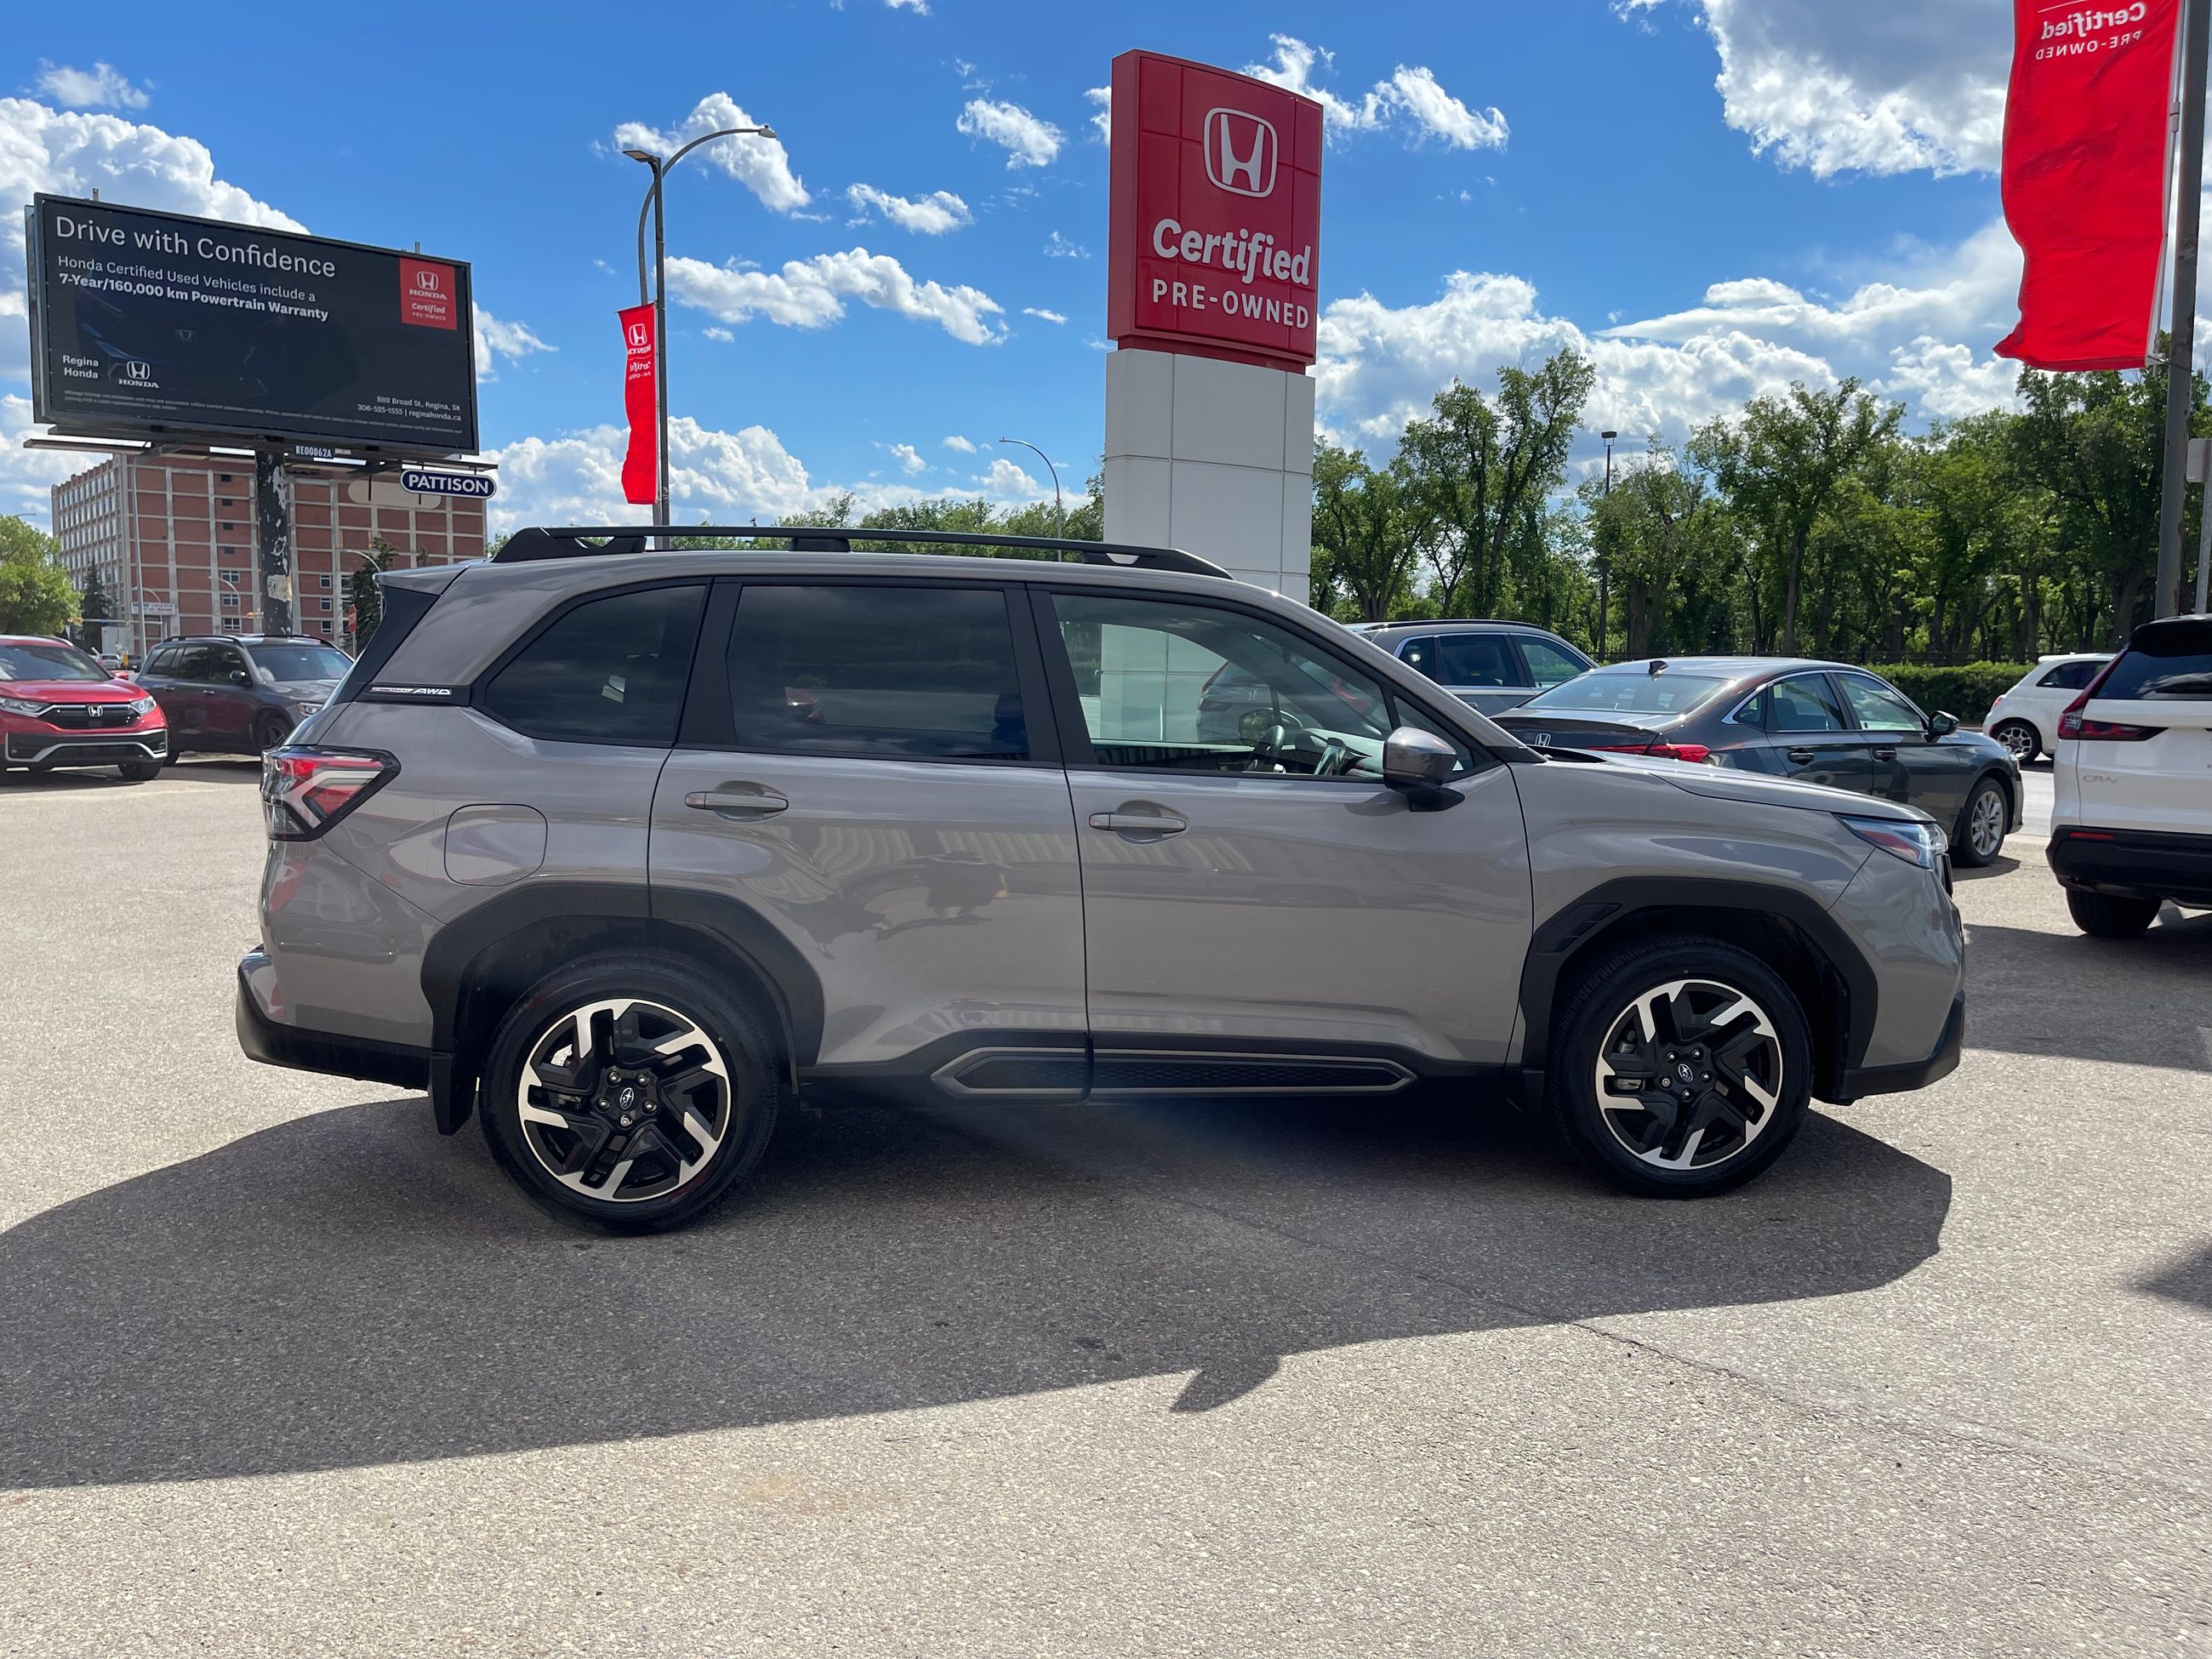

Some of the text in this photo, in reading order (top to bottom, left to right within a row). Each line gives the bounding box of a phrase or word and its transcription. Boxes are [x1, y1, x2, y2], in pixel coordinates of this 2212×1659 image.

[56, 216, 336, 277] Drive with Confidence
[1153, 218, 1311, 286] Certified
[58, 255, 316, 302] Honda Certified Used Vehicles include a
[59, 272, 328, 322] 7-Year/160,000 km Powertrain Warranty
[409, 288, 448, 299] HONDA
[412, 302, 446, 314] Certified
[1153, 278, 1309, 329] PRE-OWNED
[62, 354, 100, 368] Regina
[64, 367, 100, 379] Honda
[118, 379, 160, 389] HONDA
[391, 397, 413, 407] Broad
[425, 401, 451, 412] Regina,
[408, 409, 462, 422] reginahonda.ca
[295, 446, 332, 458] RE00062A
[408, 473, 488, 495] PATTISON
[412, 687, 452, 696] AWD
